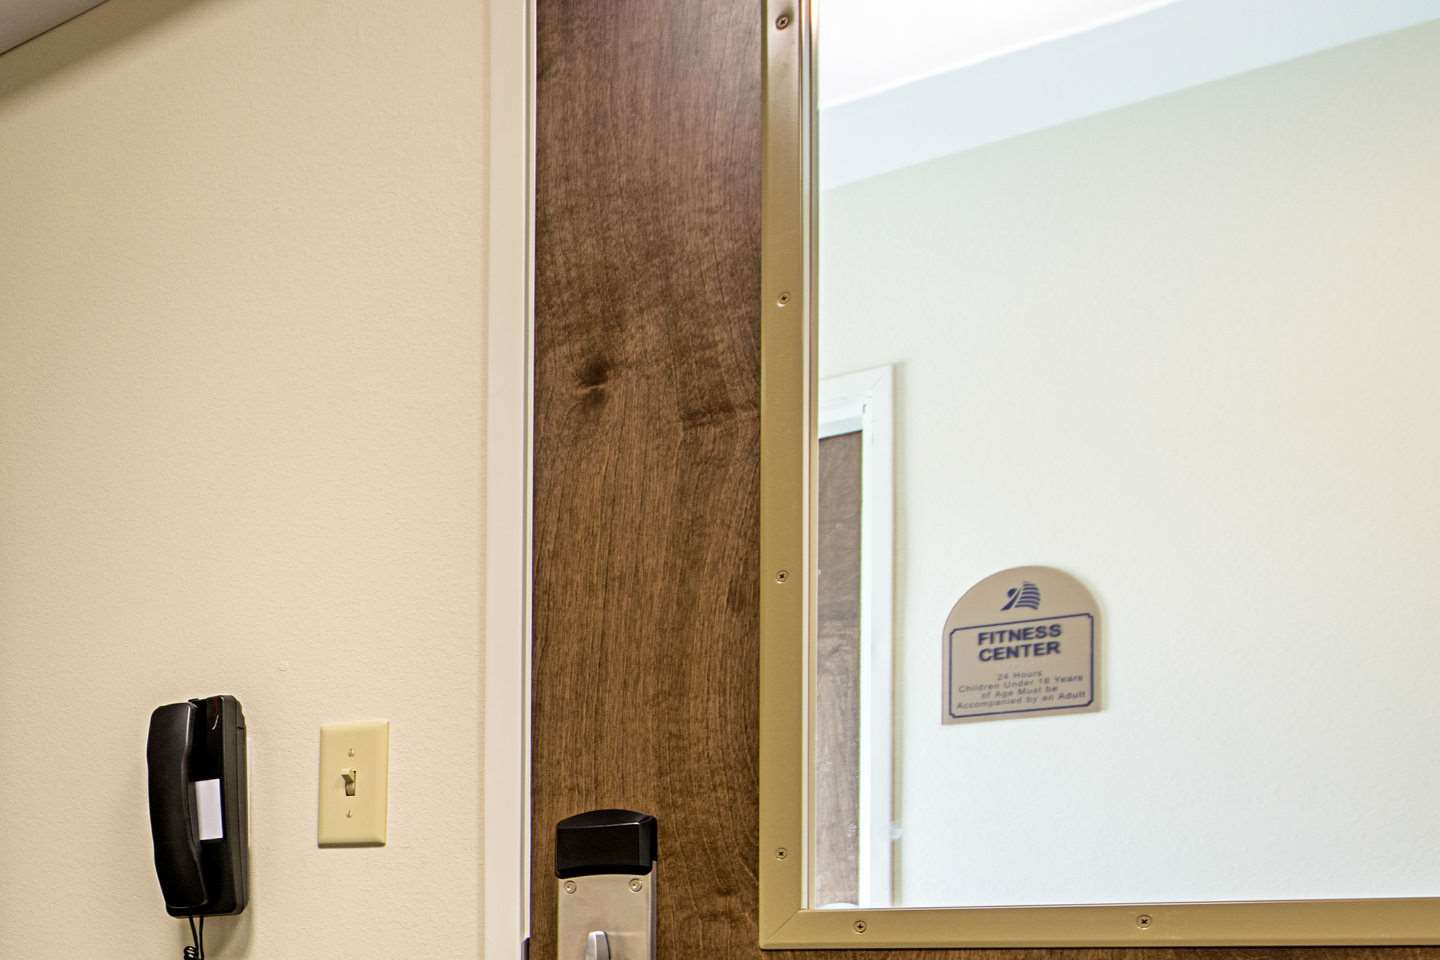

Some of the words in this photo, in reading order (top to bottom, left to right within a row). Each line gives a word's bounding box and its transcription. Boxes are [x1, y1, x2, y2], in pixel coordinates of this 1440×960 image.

[978, 624, 1062, 645] FITNESS
[978, 641, 1061, 662] CENTER
[1012, 670, 1042, 679] Hours
[958, 682, 1000, 693] Children
[1003, 679, 1034, 689] Under
[1055, 675, 1083, 683] Years
[981, 691, 991, 699] of
[995, 690, 1014, 699] Age
[1017, 687, 1042, 696] Must
[1045, 685, 1059, 693] be
[957, 697, 1022, 708] Accompanied
[1026, 695, 1039, 704] by
[1042, 694, 1055, 702] an
[1058, 691, 1086, 700] Adult
